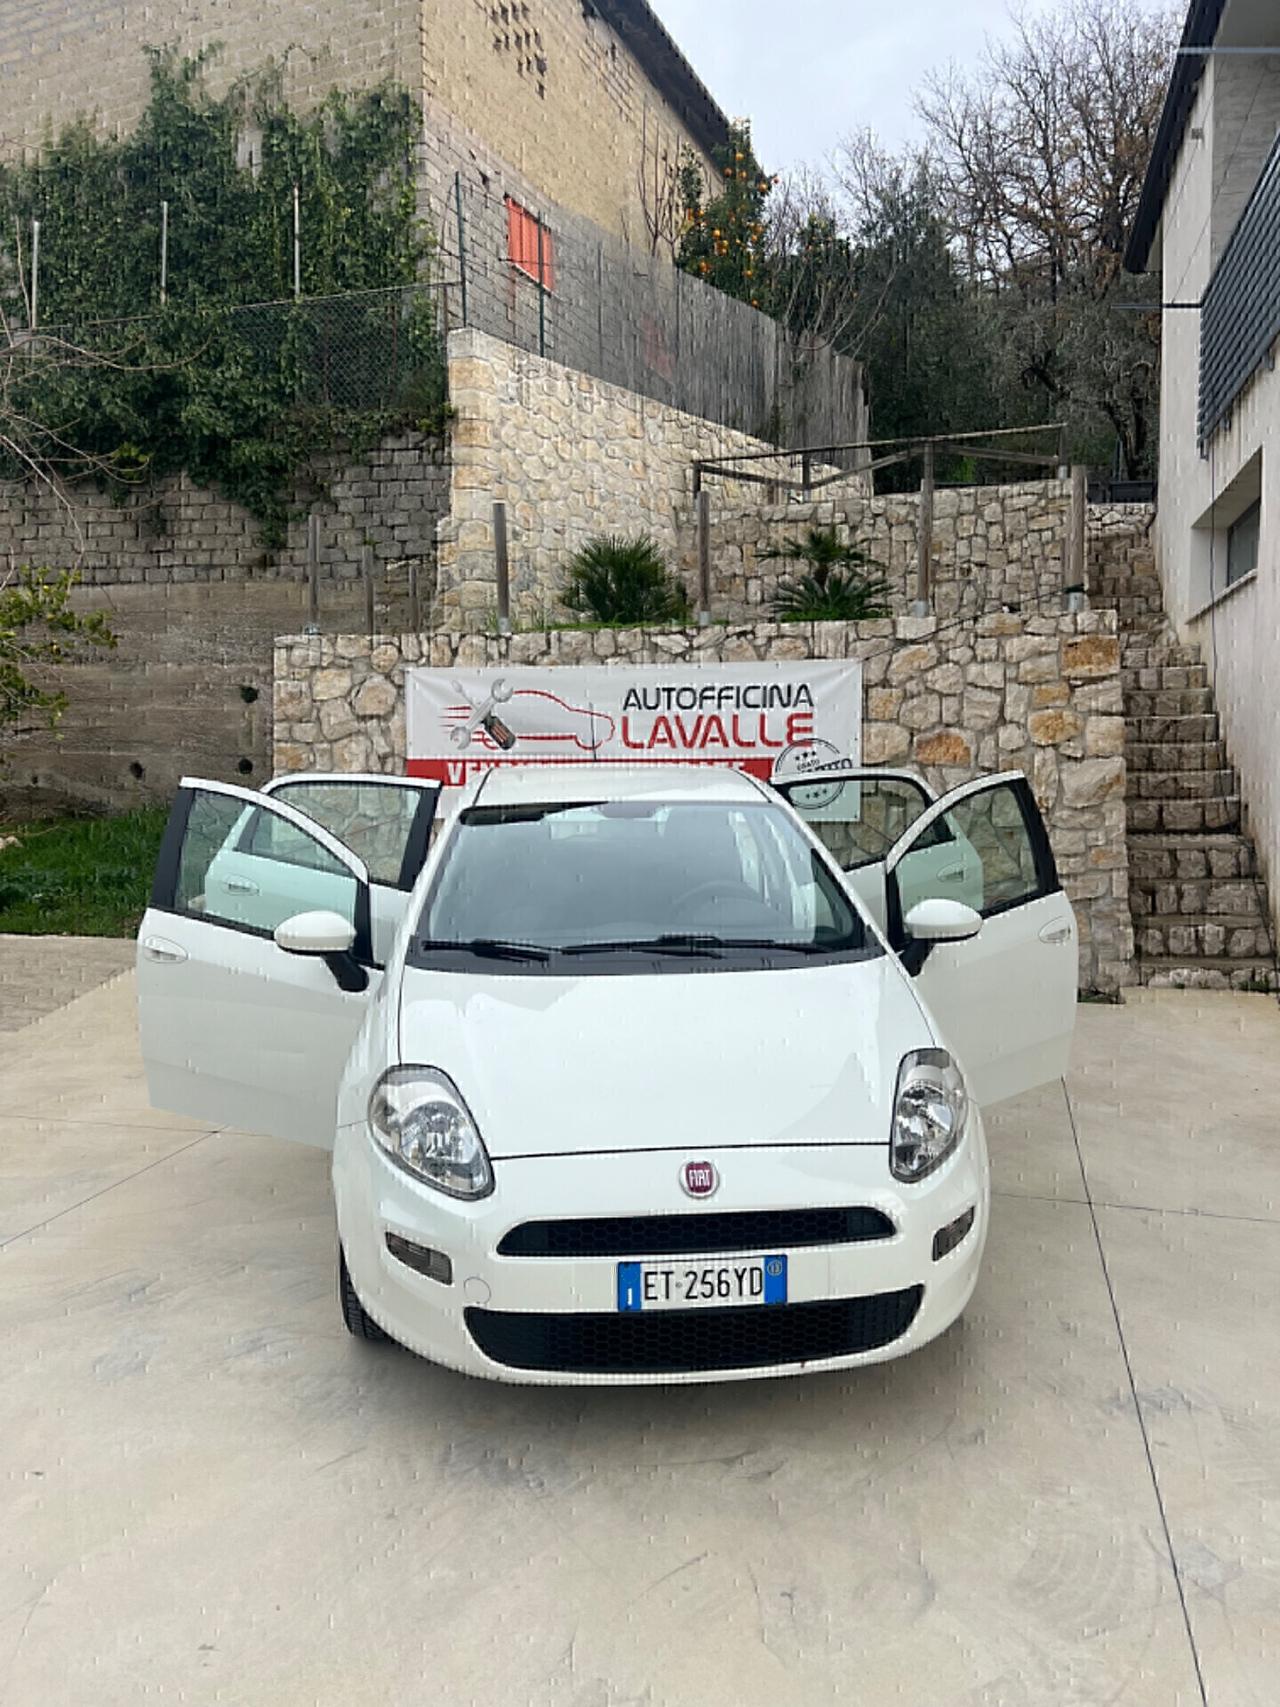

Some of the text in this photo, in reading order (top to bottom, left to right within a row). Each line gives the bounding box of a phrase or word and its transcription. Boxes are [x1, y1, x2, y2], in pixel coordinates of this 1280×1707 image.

[623, 684, 814, 711] AUTOFFICINA
[622, 712, 814, 749] LAVALLE
[688, 1169, 710, 1187] FIAT
